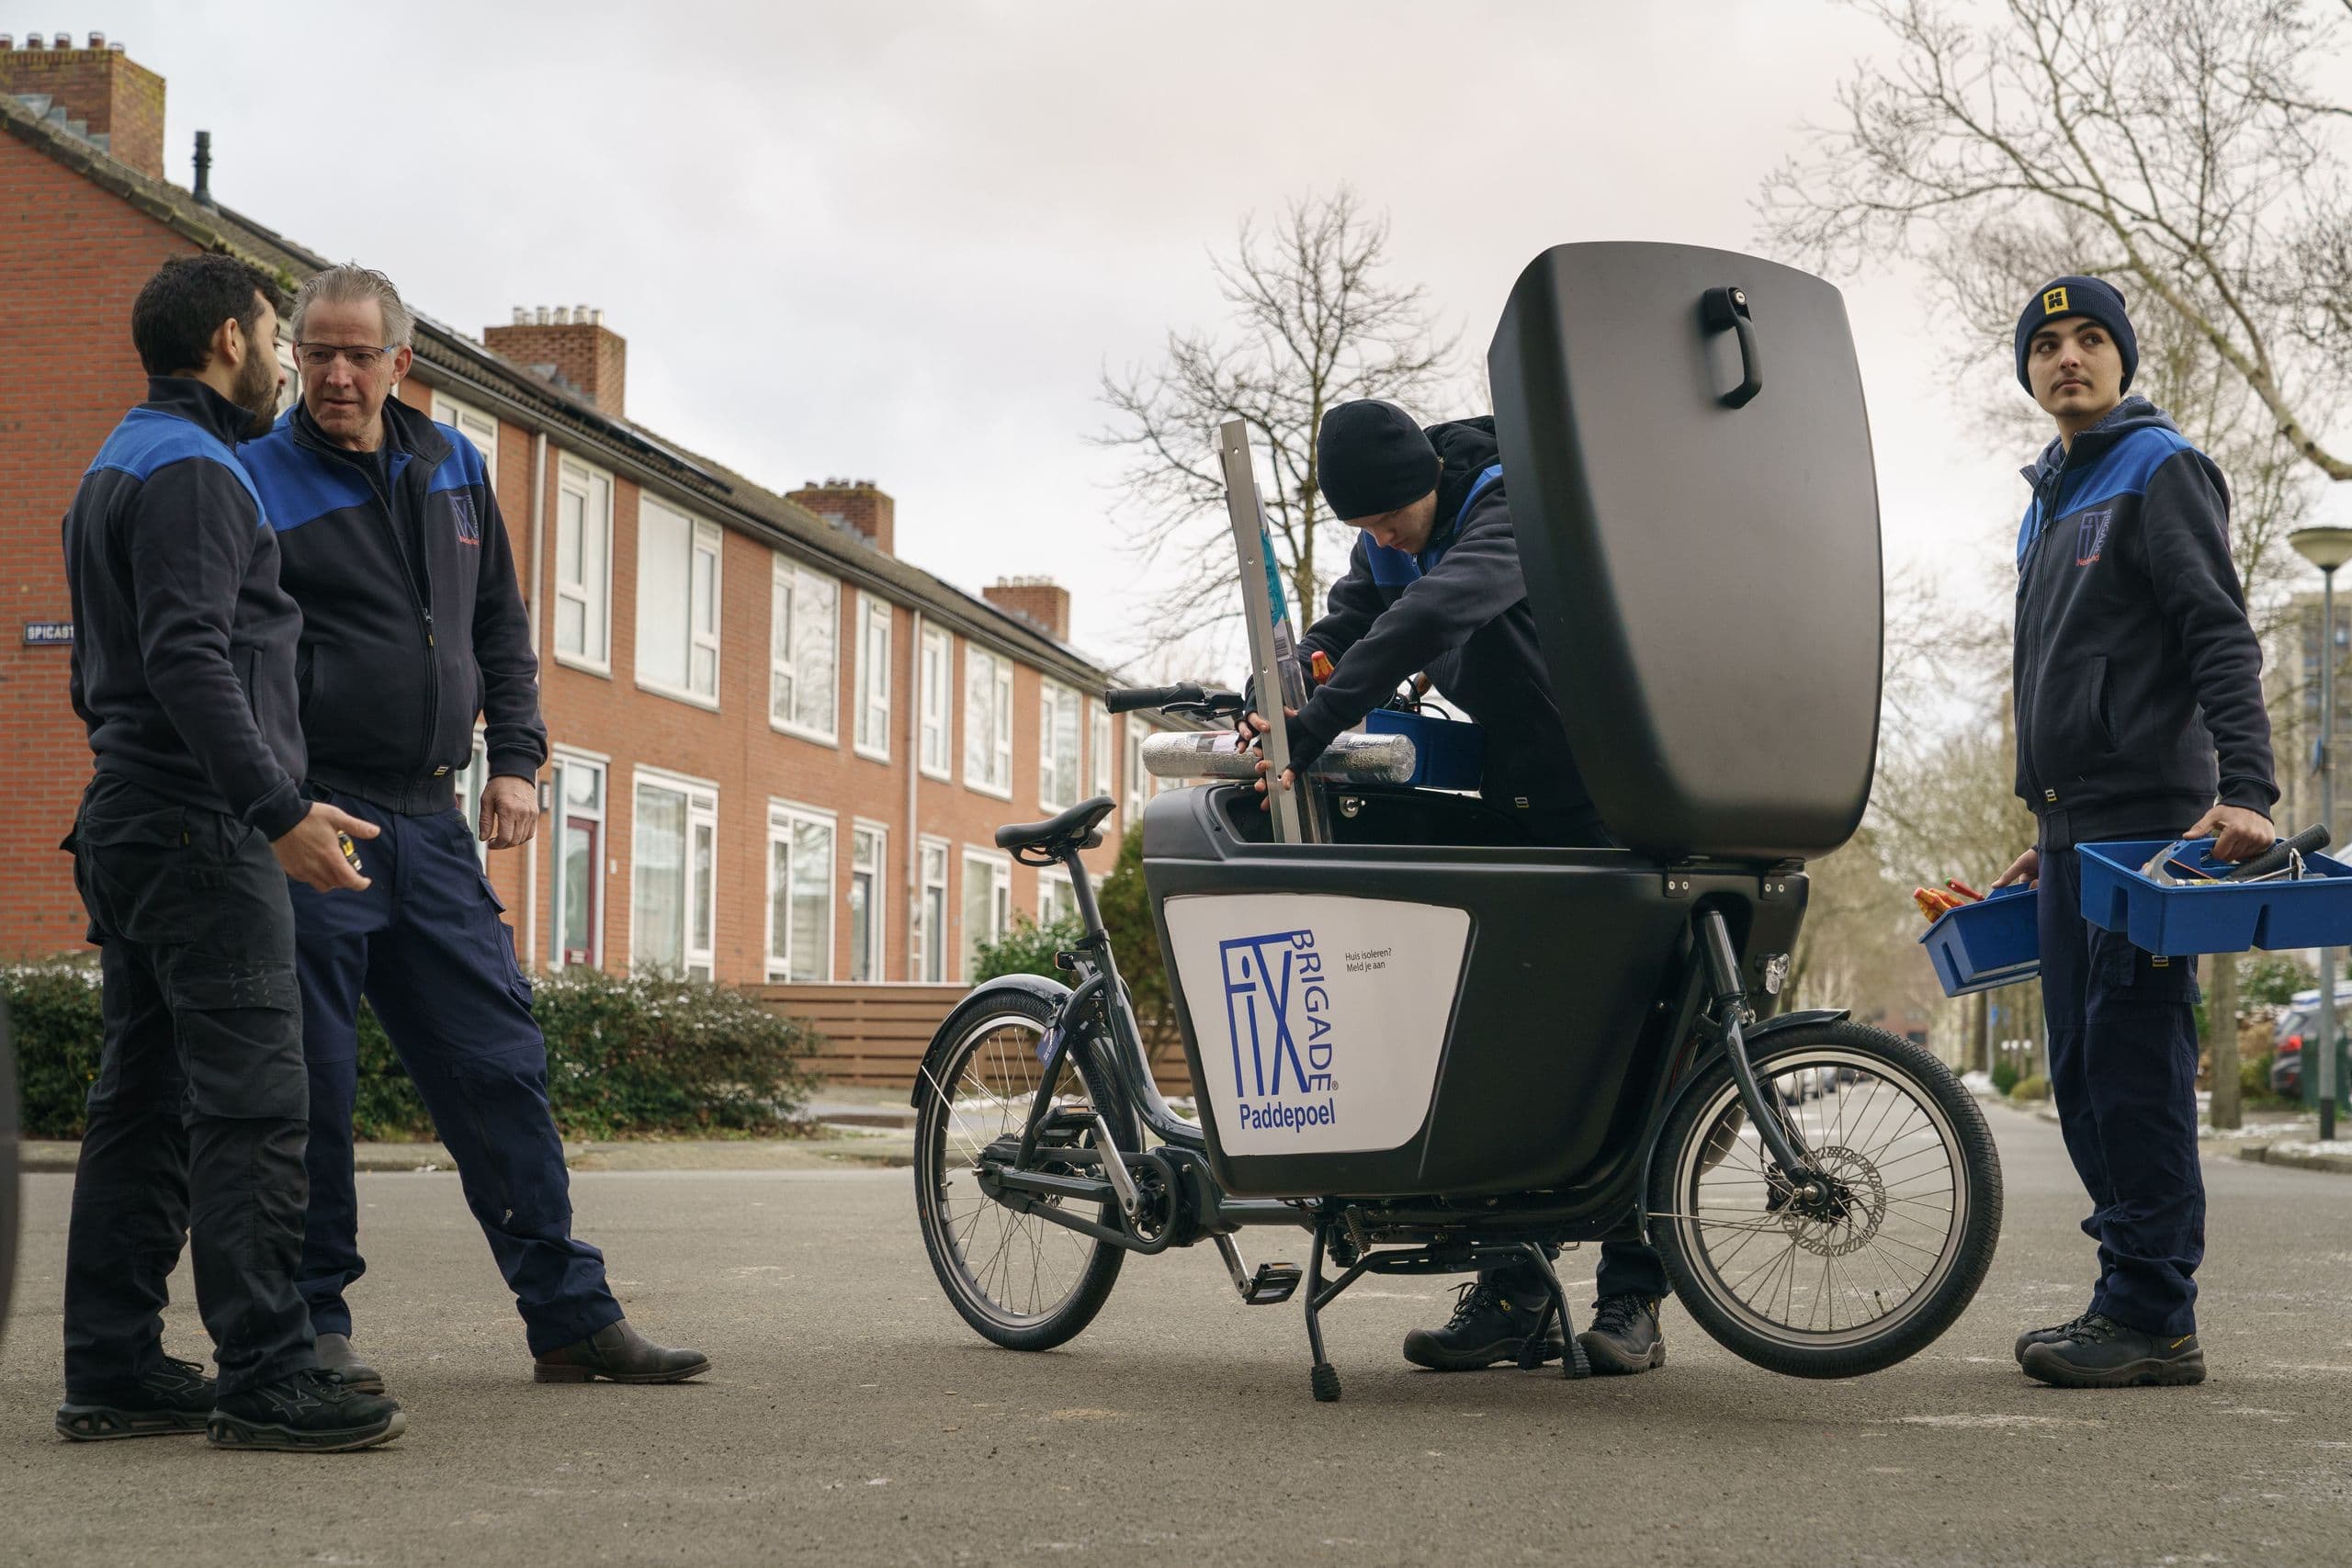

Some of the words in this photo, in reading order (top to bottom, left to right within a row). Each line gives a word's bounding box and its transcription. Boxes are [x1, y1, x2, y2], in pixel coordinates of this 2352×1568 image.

[1345, 951, 1361, 961] Huis
[1361, 947, 1392, 960] isoleren?
[1346, 962, 1364, 973] Meld
[1364, 962, 1372, 973] je
[1373, 961, 1385, 970] aan
[1239, 1097, 1336, 1134] Paddepoel
